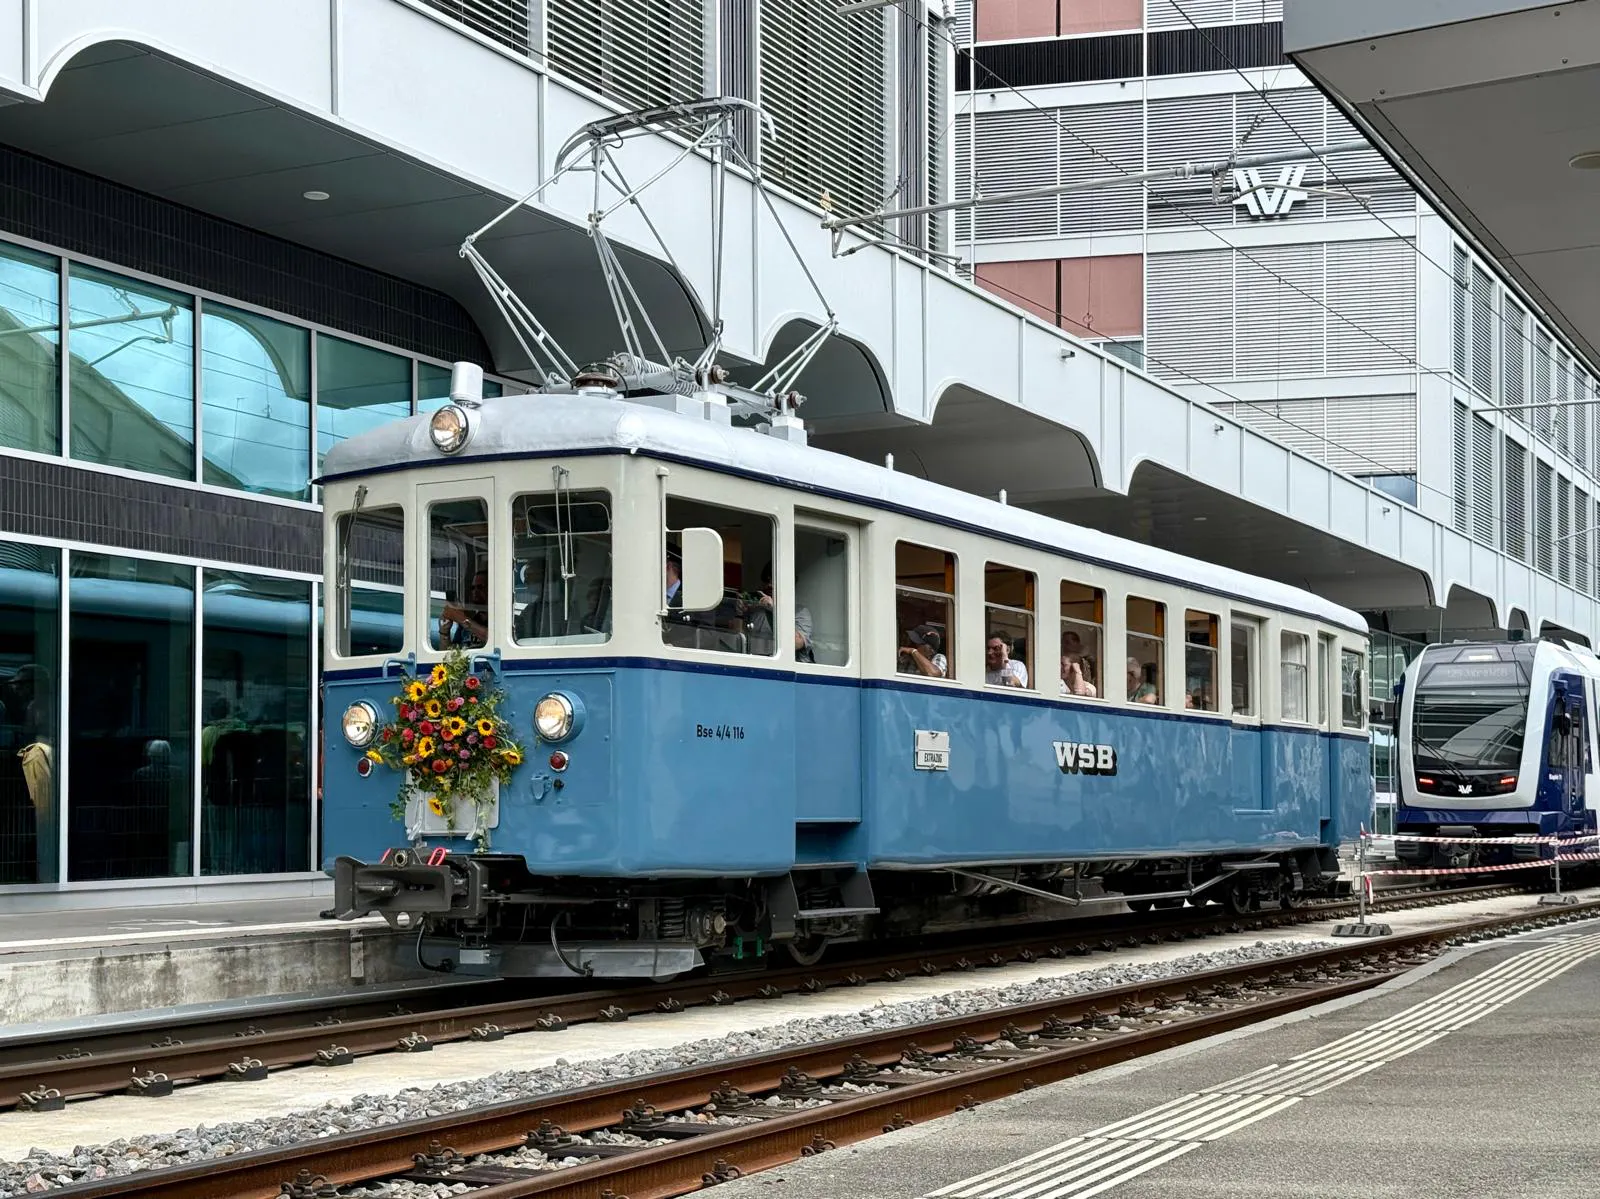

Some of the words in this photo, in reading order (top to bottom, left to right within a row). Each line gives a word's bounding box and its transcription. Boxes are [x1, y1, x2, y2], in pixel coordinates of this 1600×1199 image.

[696, 724, 713, 738] Bse
[716, 724, 730, 740] 4/4
[733, 726, 744, 739] 116
[1053, 741, 1116, 774] WSB
